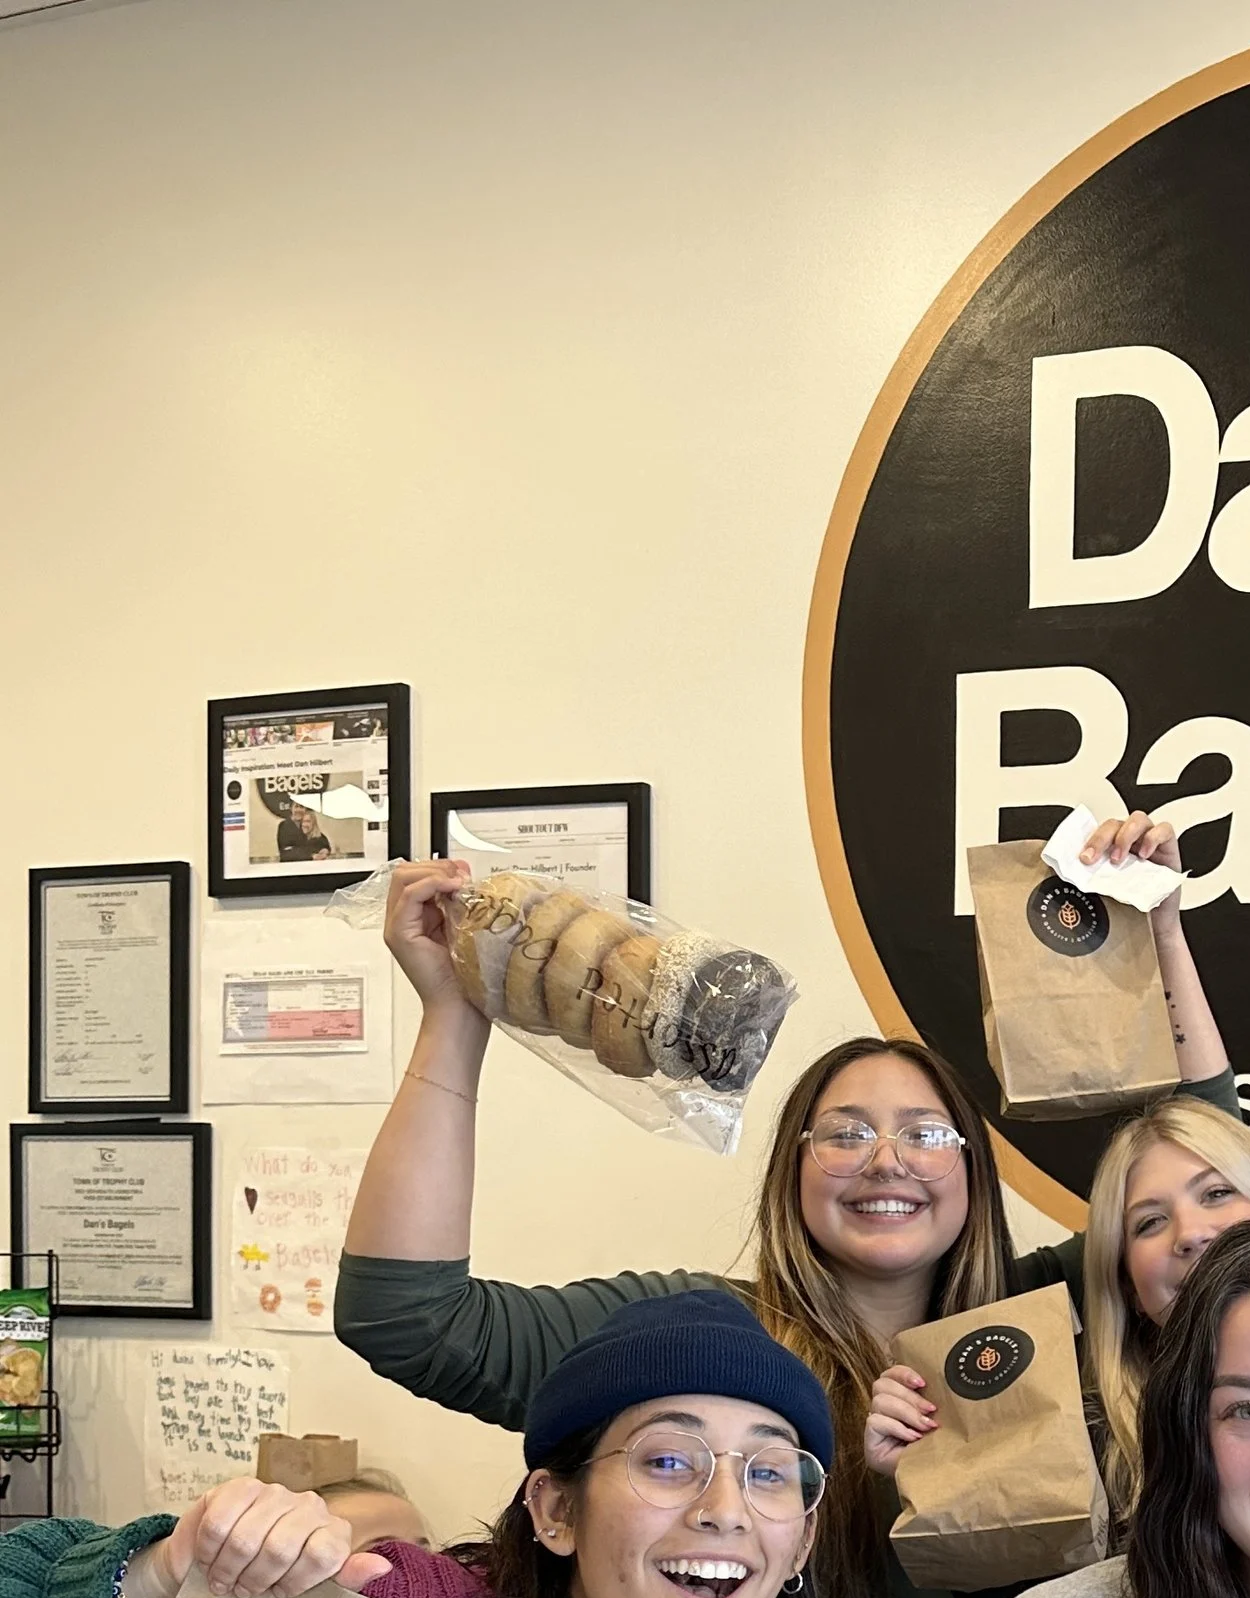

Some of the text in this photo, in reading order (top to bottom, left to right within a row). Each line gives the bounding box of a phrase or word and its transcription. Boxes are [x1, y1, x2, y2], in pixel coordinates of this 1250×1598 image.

[264, 774, 324, 794] Bagels
[565, 862, 596, 873] Founder
[1040, 888, 1061, 911] DANS
[0, 1321, 18, 1331] EEP
[958, 1339, 982, 1364] DANS
